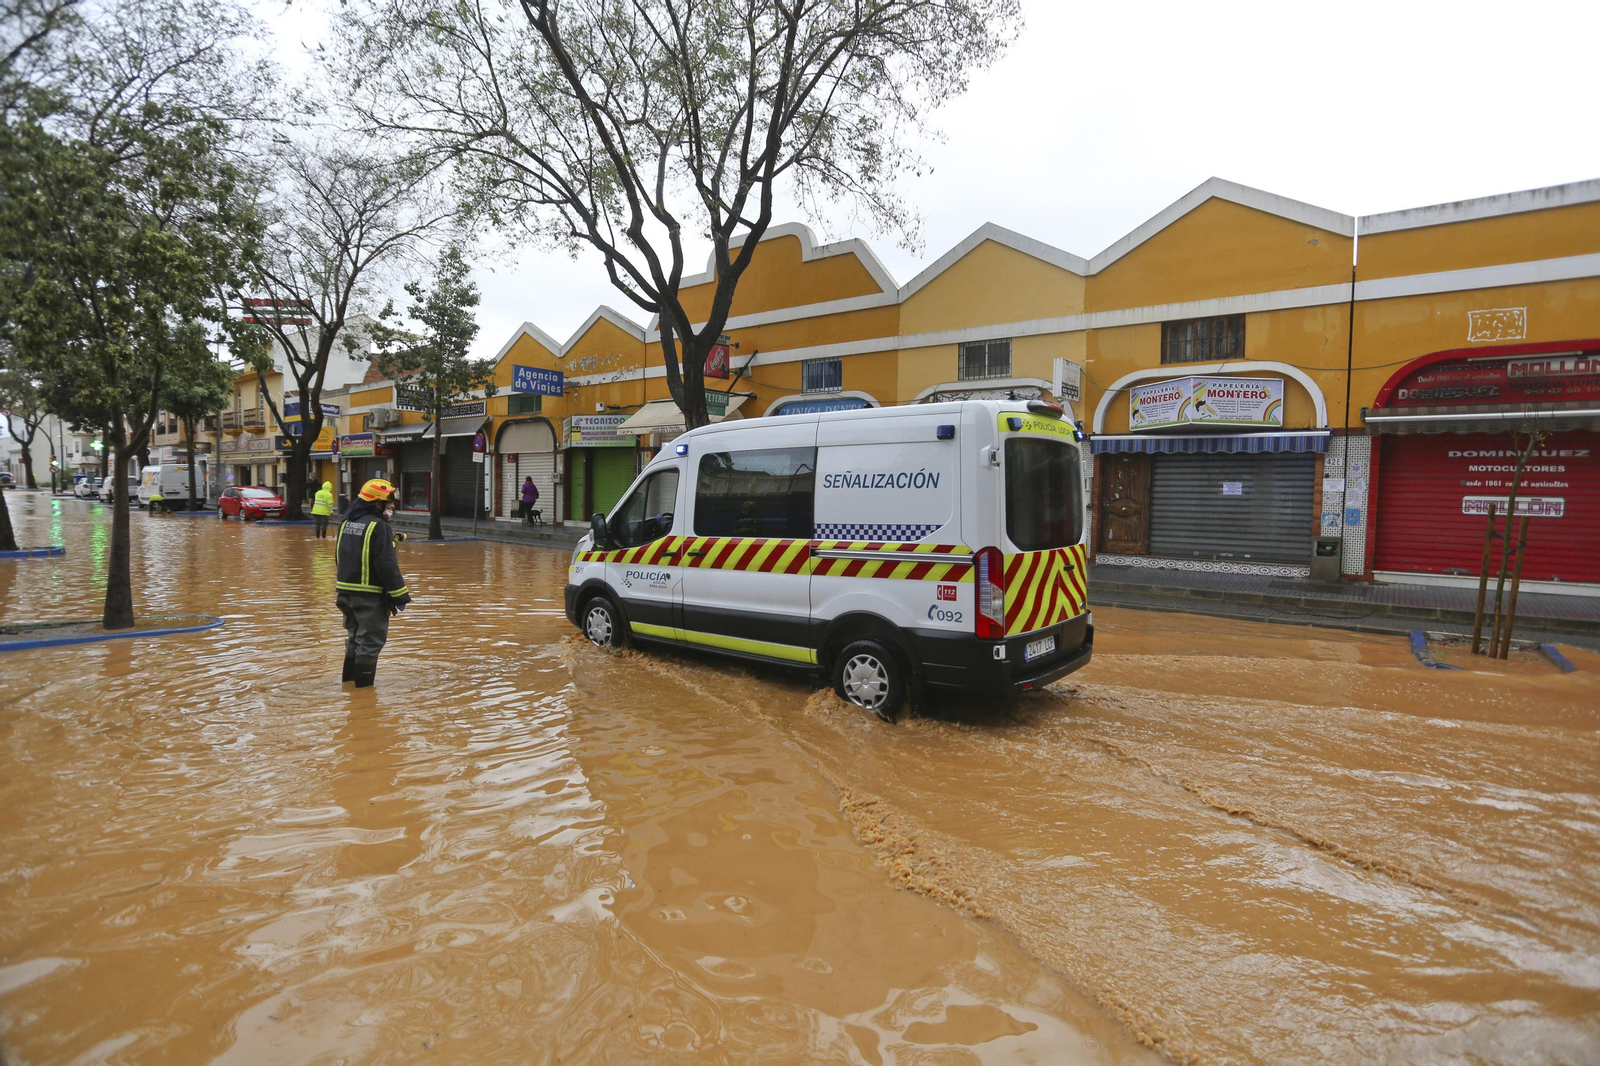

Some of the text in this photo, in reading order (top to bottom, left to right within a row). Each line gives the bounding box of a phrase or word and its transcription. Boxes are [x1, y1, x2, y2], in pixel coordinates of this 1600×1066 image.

[519, 367, 558, 381] Agencia
[1417, 375, 1435, 383] Desde
[515, 378, 561, 394] de Viajes
[1139, 391, 1181, 406] MONTERO
[1207, 389, 1268, 399] MONTERO
[584, 417, 626, 425] TECNIZOO
[1326, 458, 1341, 466] 42E
[823, 467, 940, 489] SEÑALIZACIÓN
[1530, 480, 1569, 488] agricultor
[625, 570, 667, 581] POLICÍA
[936, 610, 963, 623] 092
[1028, 641, 1042, 656] 2417
